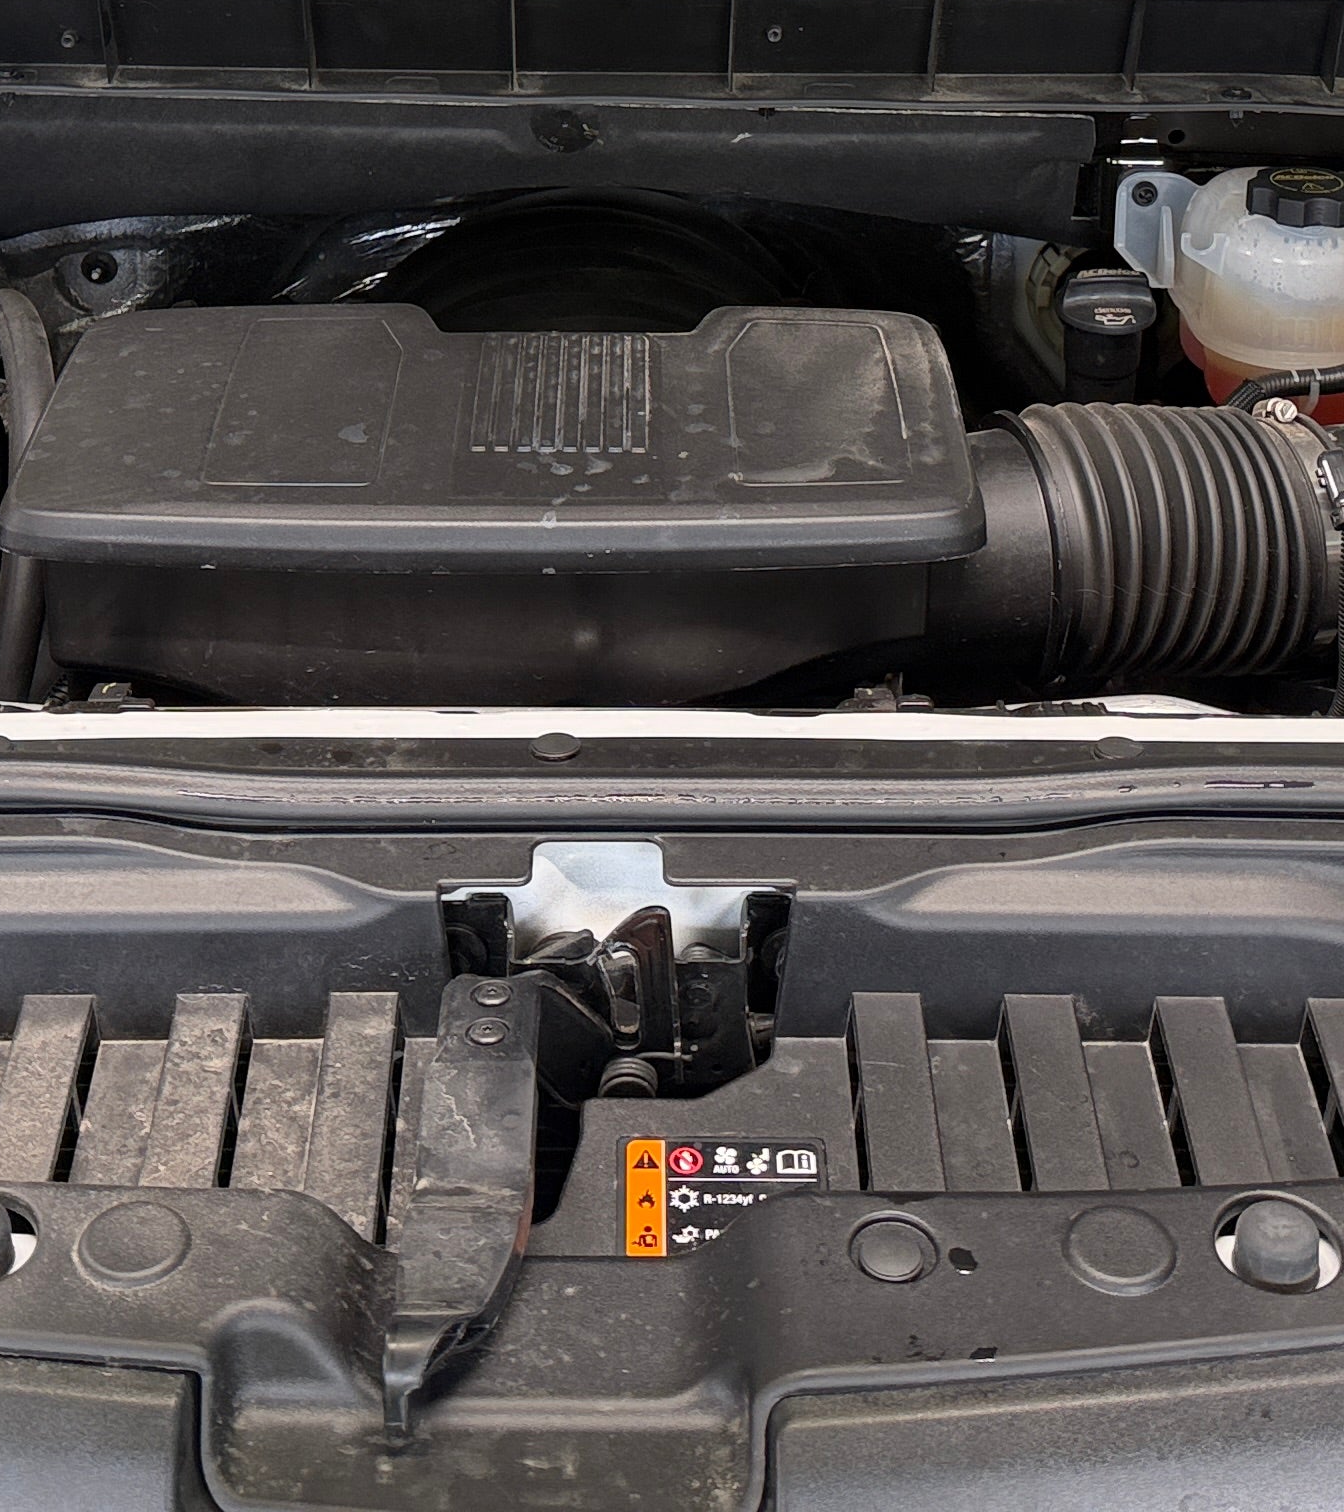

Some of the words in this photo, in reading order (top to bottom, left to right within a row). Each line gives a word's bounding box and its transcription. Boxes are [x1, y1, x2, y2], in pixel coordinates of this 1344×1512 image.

[713, 1164, 740, 1175] AUTO
[703, 1193, 754, 1207] R-1234yf
[705, 1228, 723, 1240] PA
